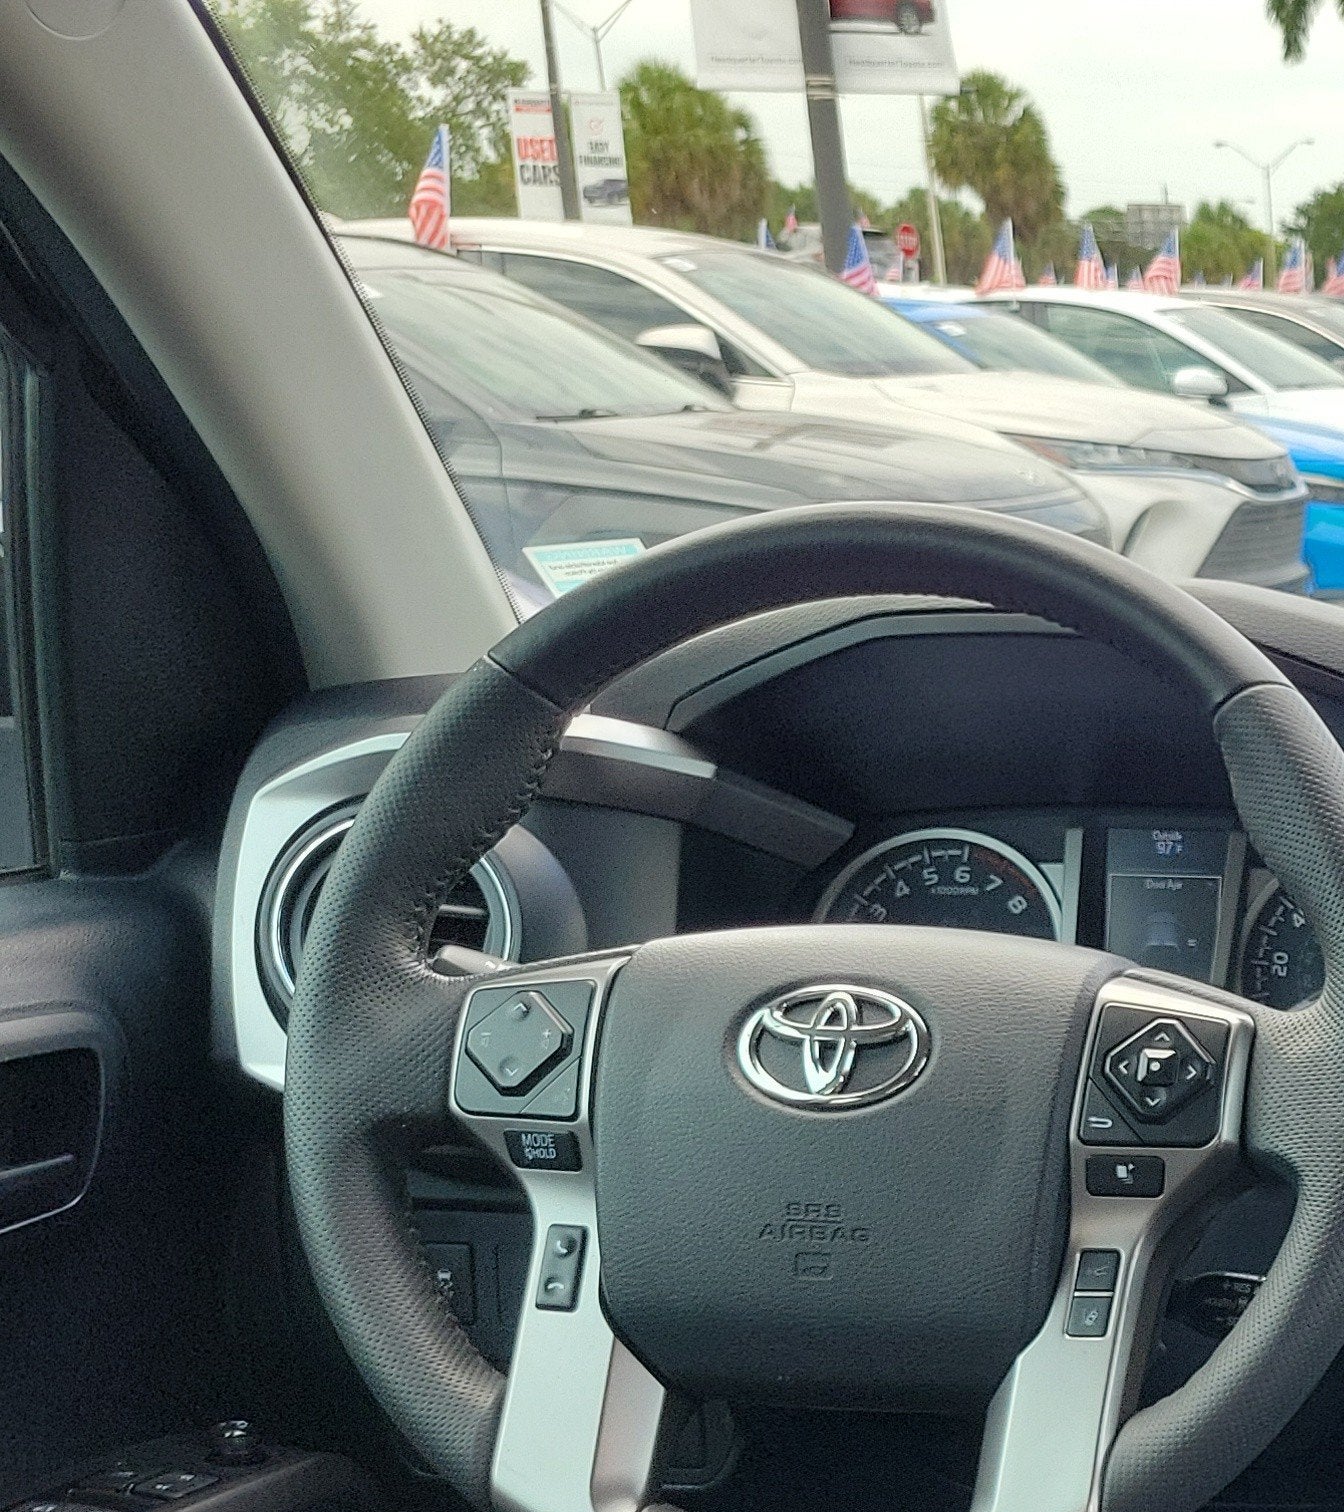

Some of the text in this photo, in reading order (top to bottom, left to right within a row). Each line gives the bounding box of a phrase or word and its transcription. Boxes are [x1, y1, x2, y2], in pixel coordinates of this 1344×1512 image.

[923, 866, 940, 886] 5
[954, 866, 972, 884] 6
[985, 874, 1004, 892] 7
[895, 880, 911, 897] 4
[868, 903, 888, 922] 3
[1007, 895, 1028, 915] 8
[1271, 951, 1289, 978] 20
[521, 1132, 556, 1148] MODE
[533, 1148, 557, 1159] HOLD
[781, 1201, 841, 1219] SRS
[758, 1222, 870, 1242] AIRBAG
